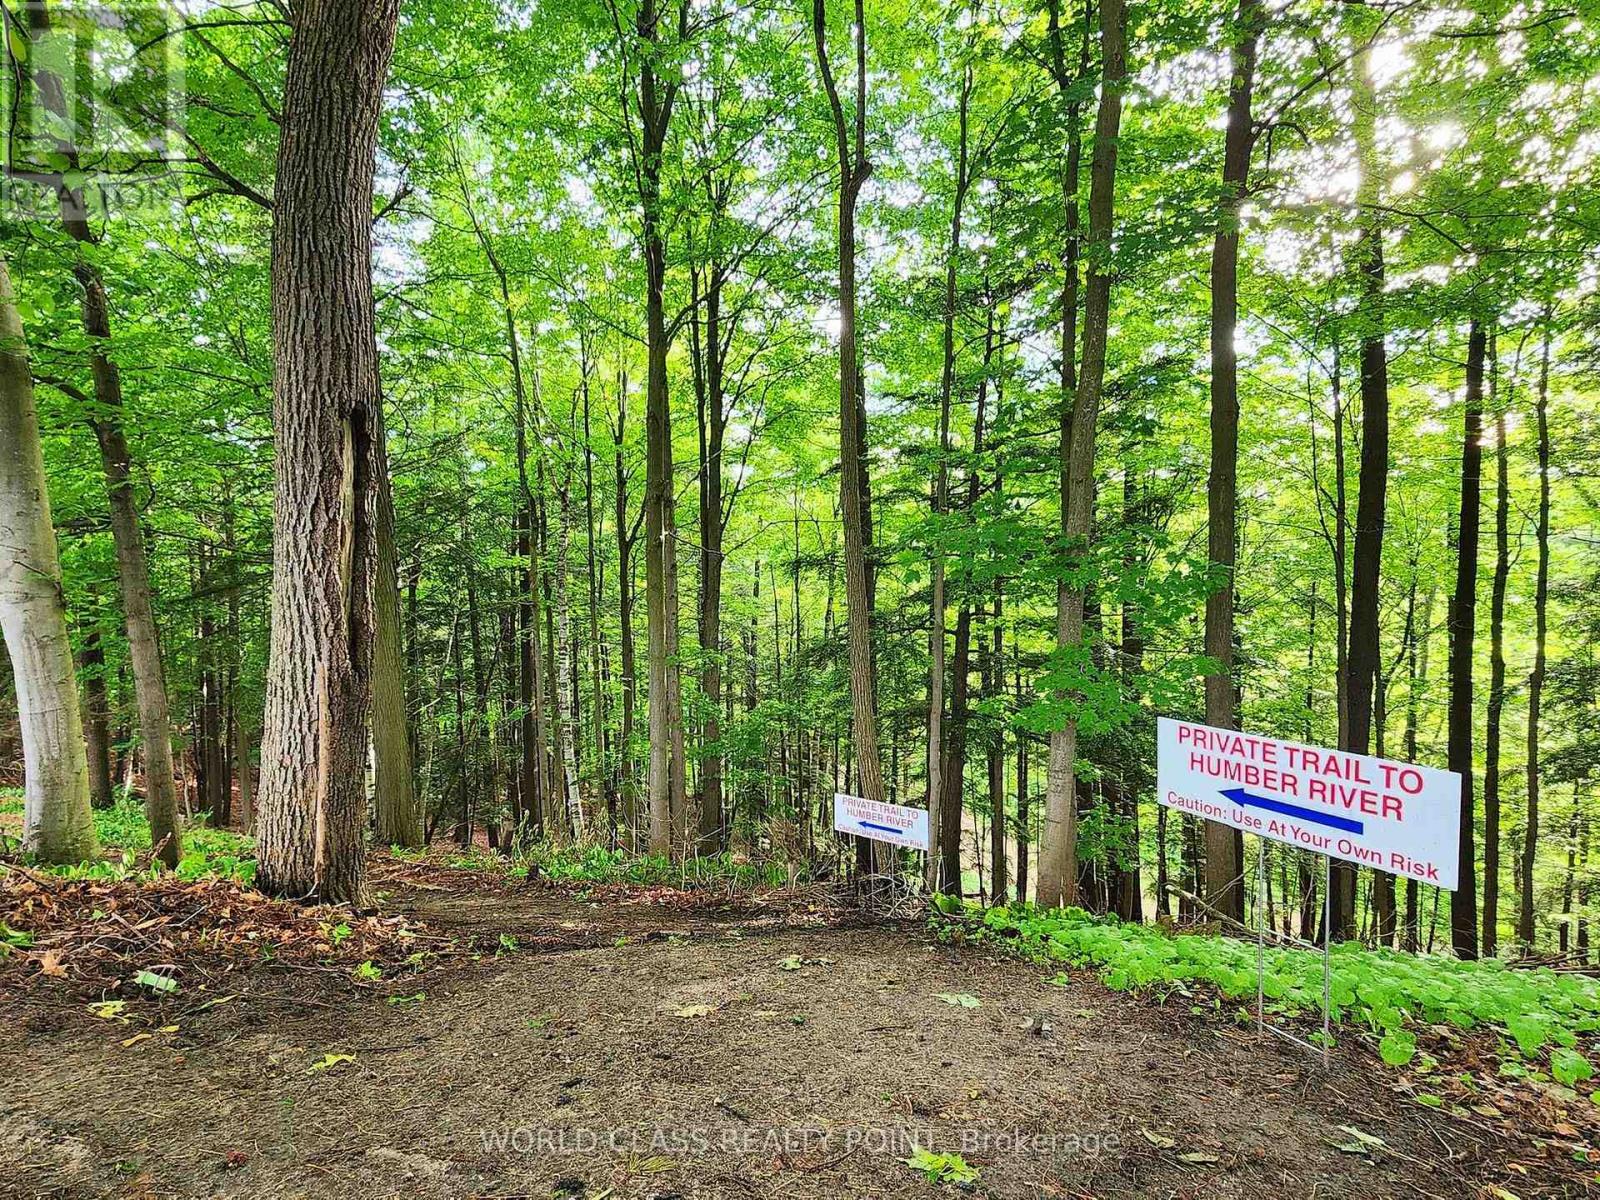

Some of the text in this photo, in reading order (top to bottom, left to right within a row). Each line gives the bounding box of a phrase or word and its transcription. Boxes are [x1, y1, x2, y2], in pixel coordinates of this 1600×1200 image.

[1179, 725, 1424, 795] PRIVATE TRAIL TO
[1190, 752, 1403, 821] HUMBER RIVER
[842, 796, 919, 820] PRIVATE TRAIL TO
[846, 807, 913, 829] HUMBER RIVER
[1167, 791, 1440, 881] Caution: Use At Your Own Risk
